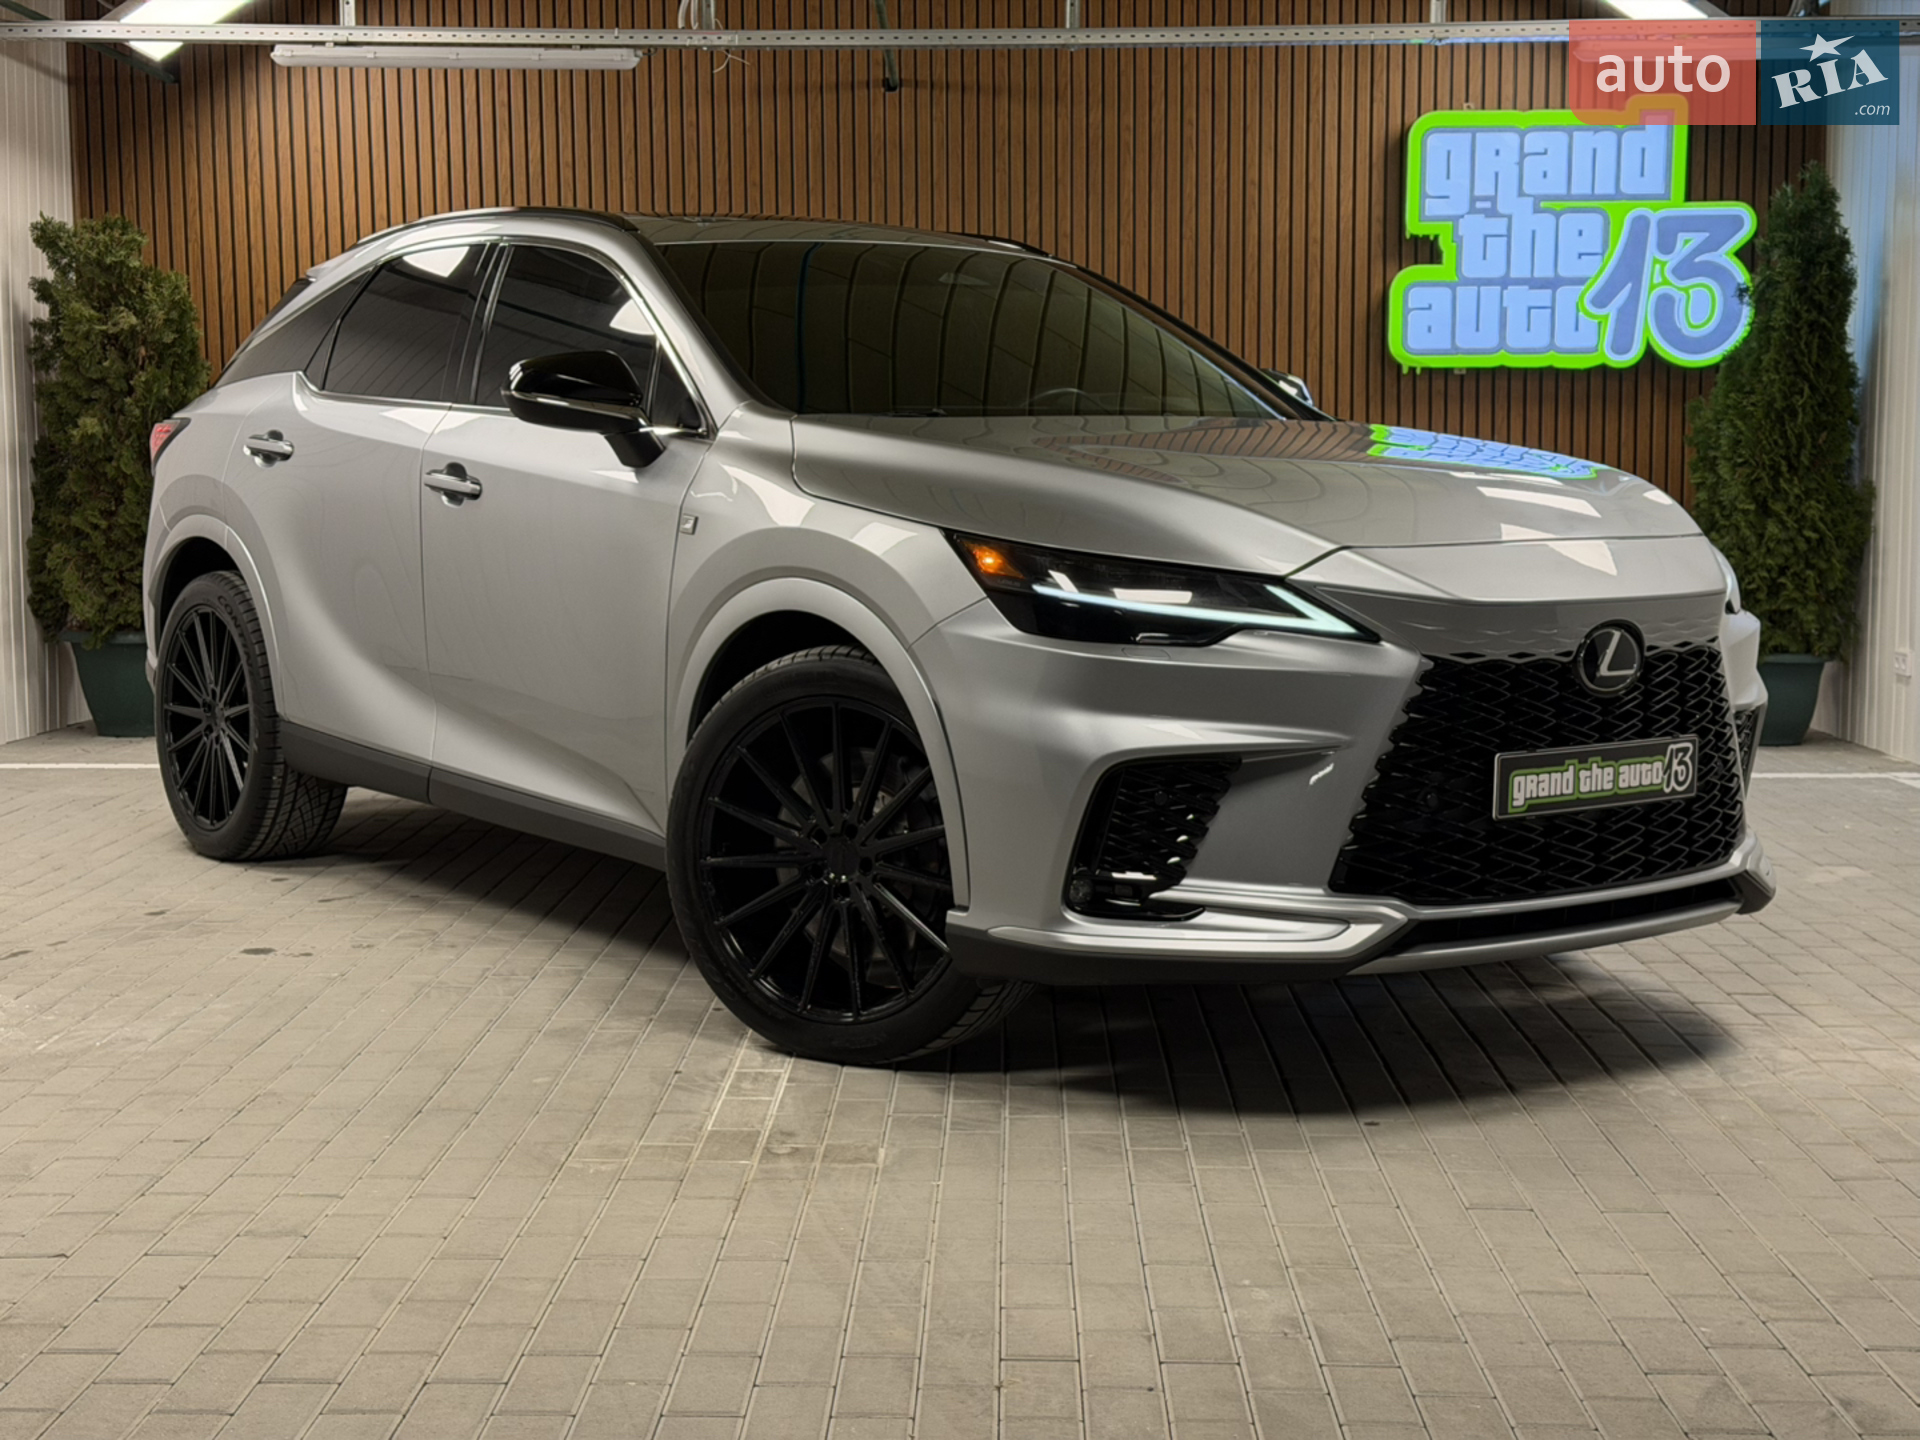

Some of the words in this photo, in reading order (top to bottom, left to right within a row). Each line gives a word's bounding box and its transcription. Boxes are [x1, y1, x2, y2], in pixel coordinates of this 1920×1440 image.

[1424, 112, 1670, 217] grand
[1458, 197, 1606, 279] the
[1406, 285, 1602, 350] auto
[1585, 207, 1751, 361] 13
[1512, 764, 1575, 808] grand
[1579, 762, 1614, 793] the
[1618, 761, 1663, 789] auto
[1662, 742, 1694, 794] 13
